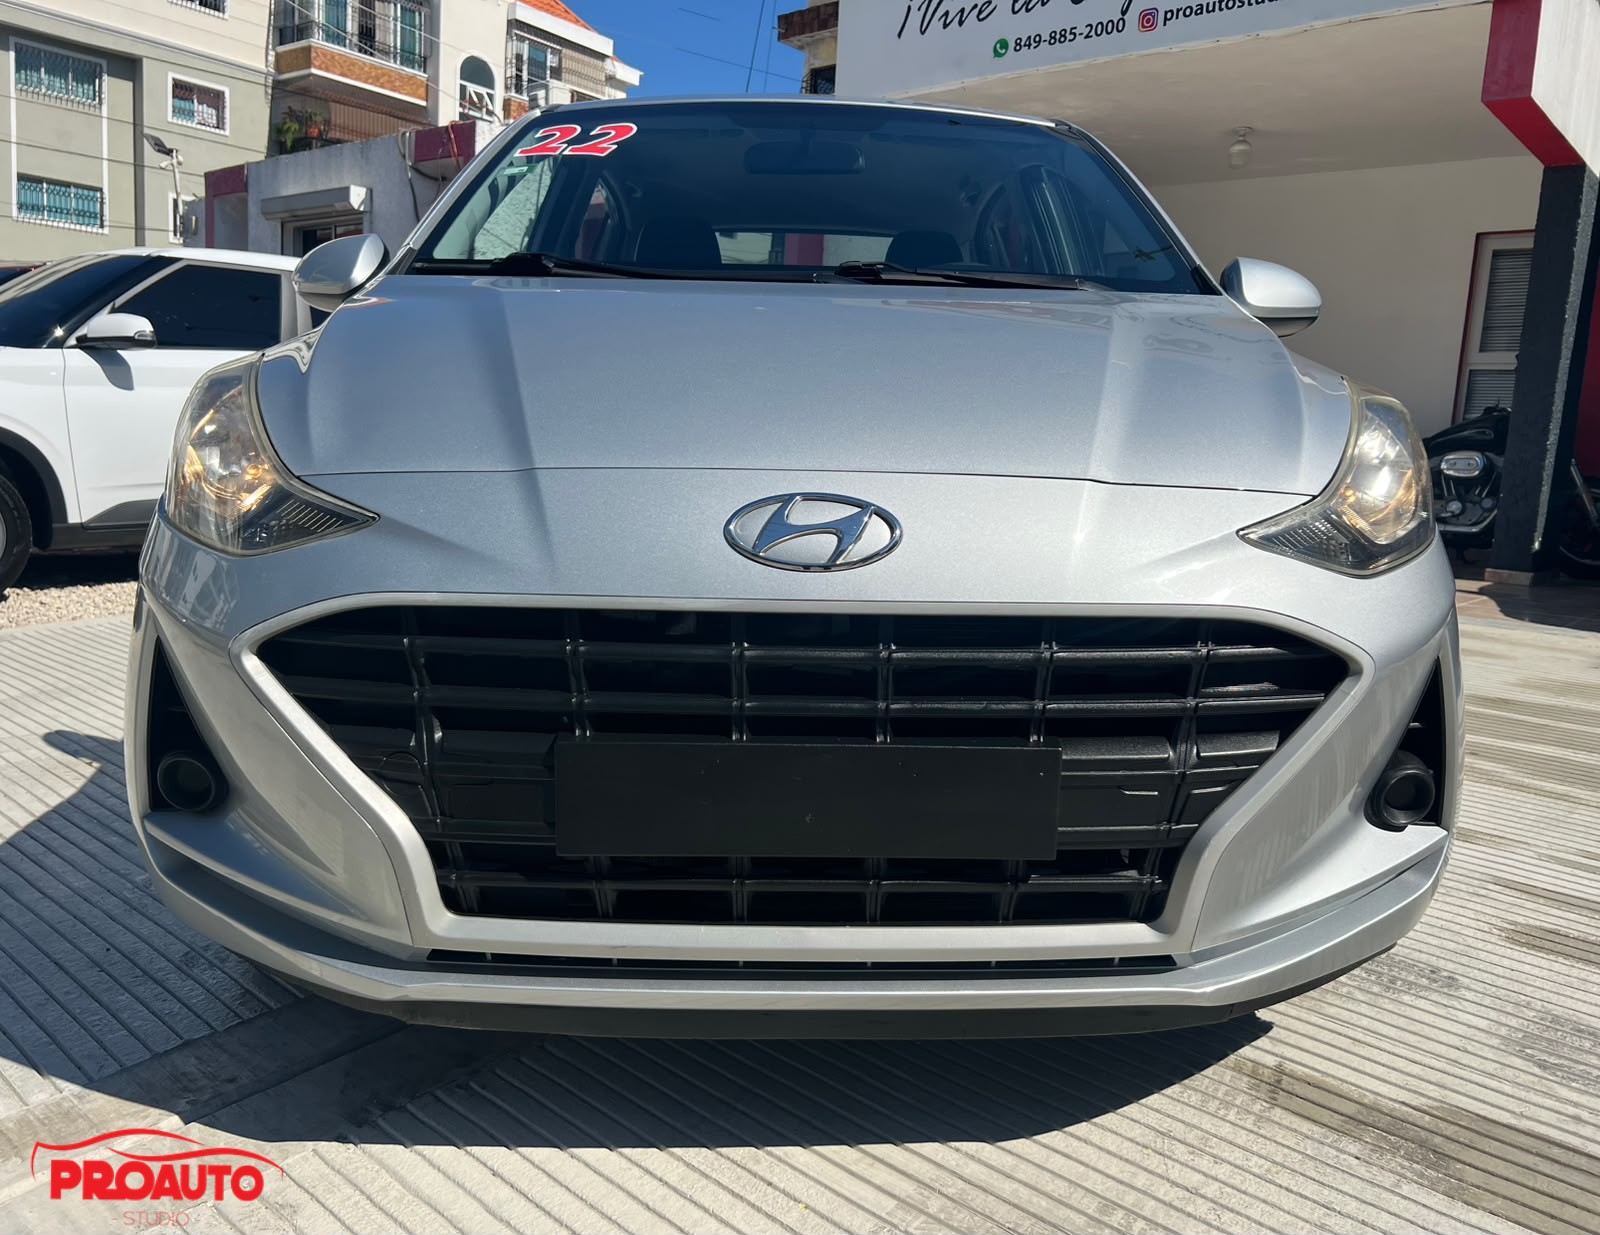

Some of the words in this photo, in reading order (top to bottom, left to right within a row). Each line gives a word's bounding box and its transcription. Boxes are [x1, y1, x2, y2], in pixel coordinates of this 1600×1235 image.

[1013, 18, 1126, 53] 849-885-2000
[1162, 0, 1279, 27] proautos
[513, 122, 638, 157] 22
